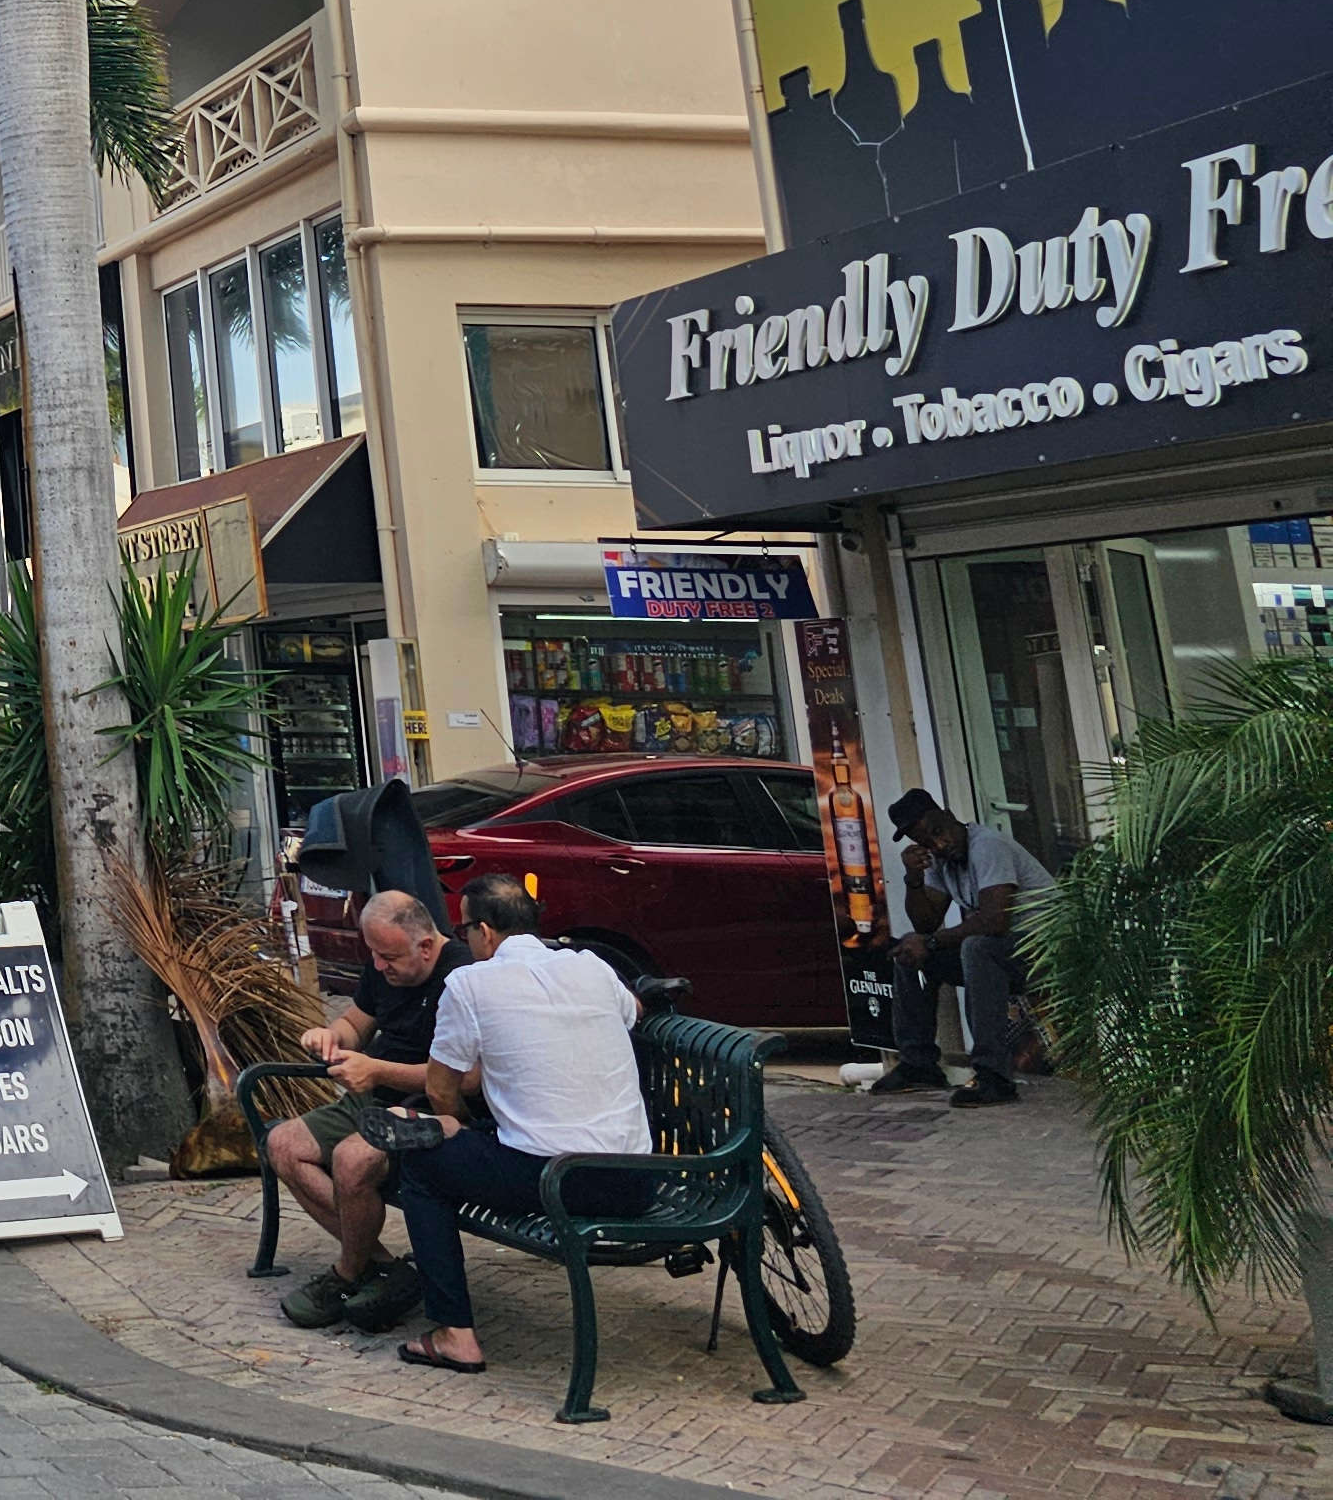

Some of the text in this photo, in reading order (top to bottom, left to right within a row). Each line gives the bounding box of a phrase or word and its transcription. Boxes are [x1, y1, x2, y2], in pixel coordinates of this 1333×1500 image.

[664, 142, 1333, 402] Friendly Duty Fre
[747, 328, 1309, 480] Liquor Tobacco Cigars
[617, 570, 790, 600] FRIENDLY
[646, 600, 702, 618] DUTY
[706, 601, 757, 618] FREE
[807, 659, 846, 683] Special
[863, 970, 877, 982] THE
[849, 979, 894, 999] GLENLIVET
